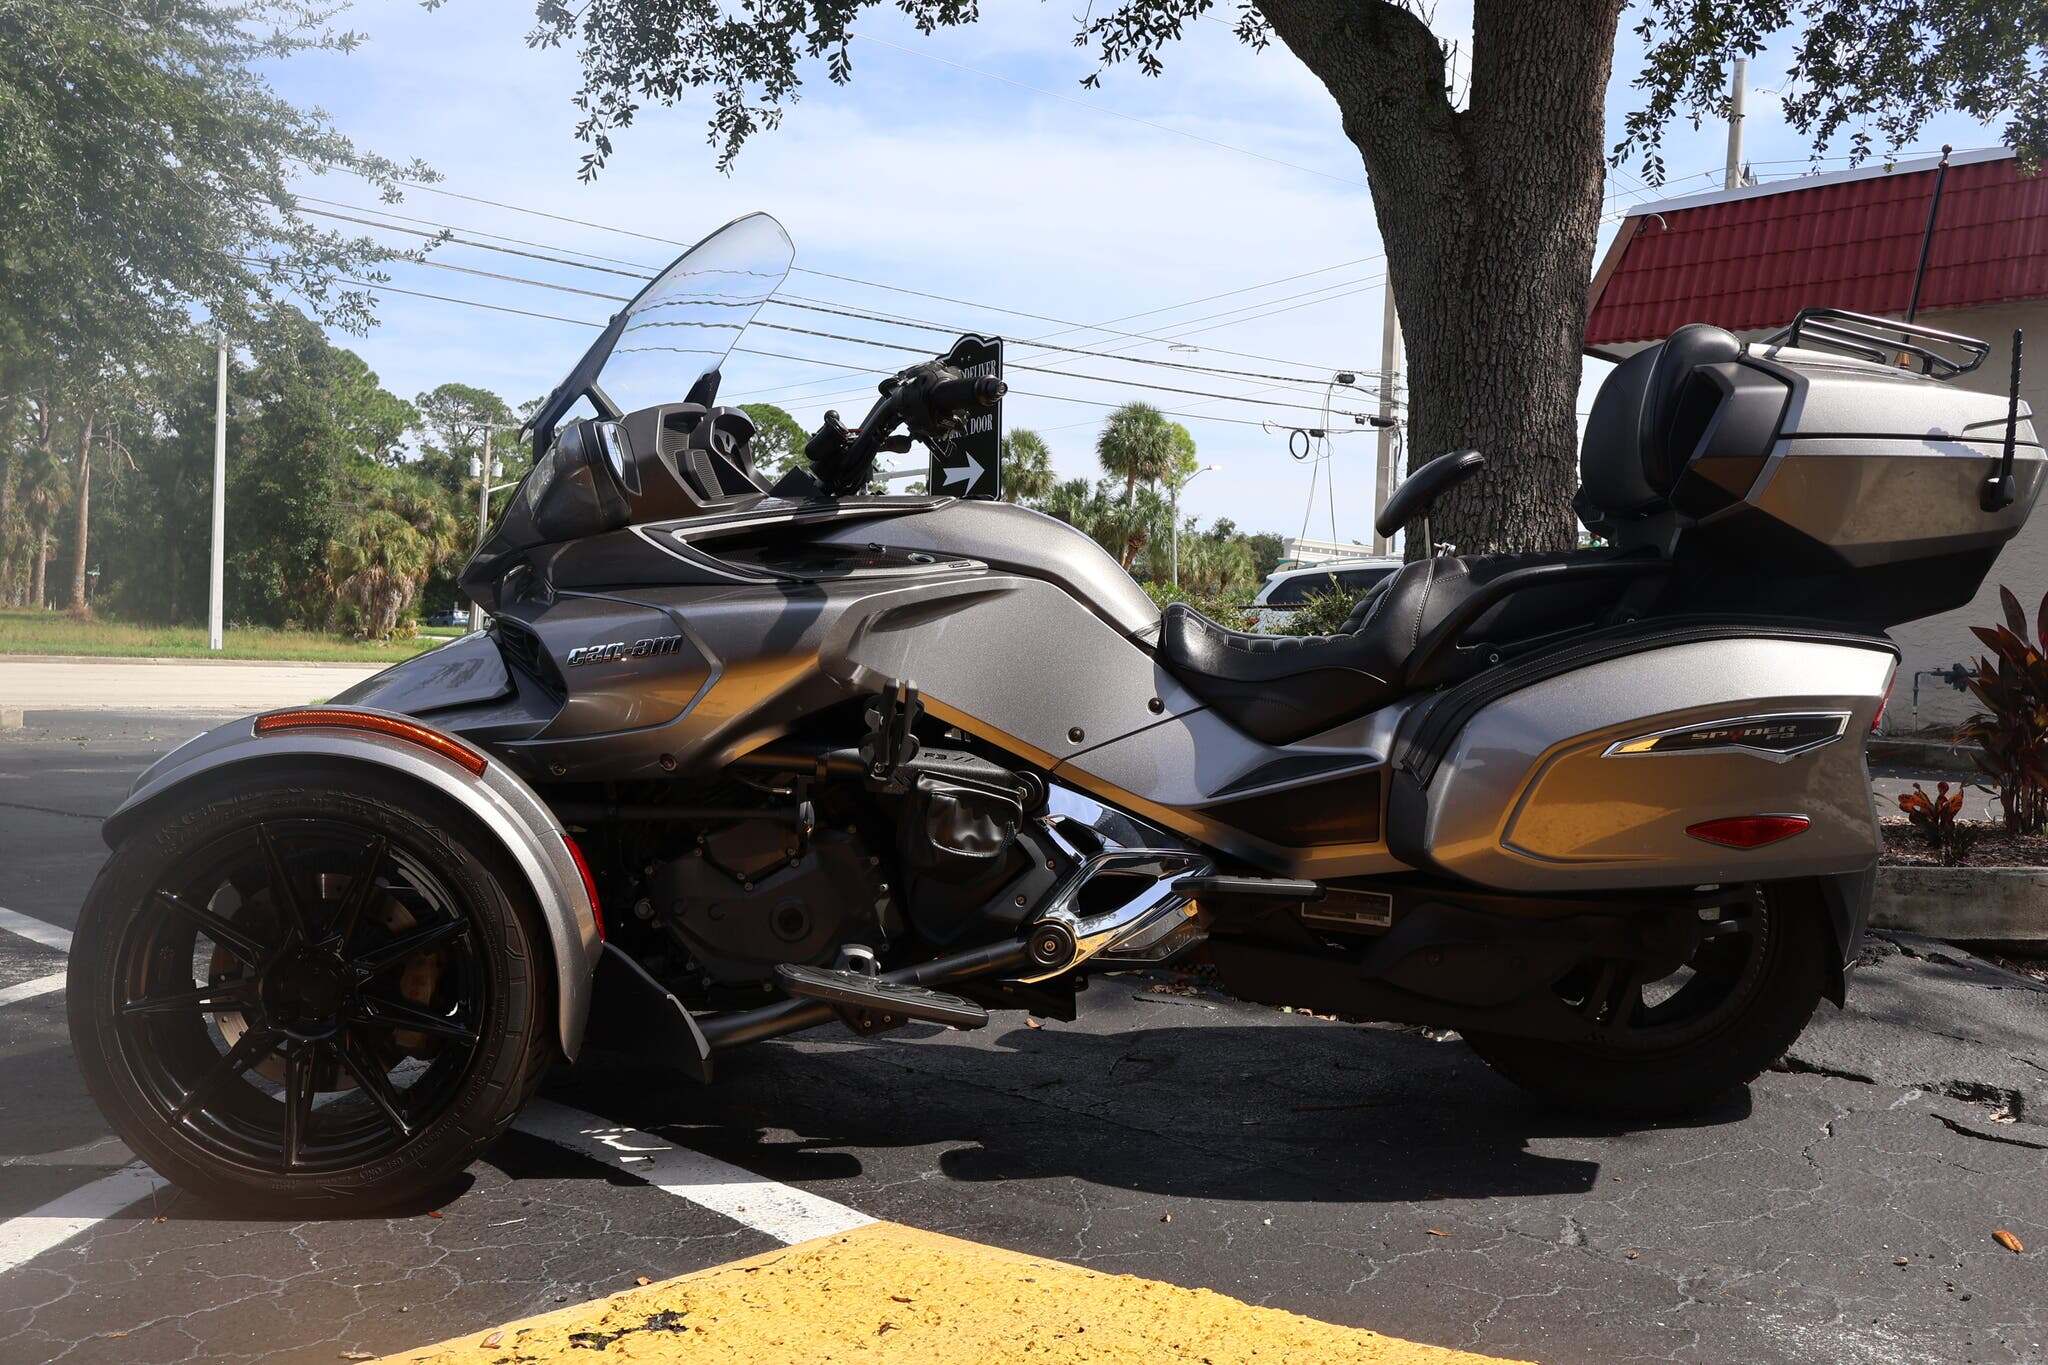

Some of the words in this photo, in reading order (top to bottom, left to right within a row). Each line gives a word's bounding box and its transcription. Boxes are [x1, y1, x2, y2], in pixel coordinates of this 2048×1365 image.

[970, 413, 993, 435] DOOR
[567, 635, 682, 666] can-am
[1691, 725, 1797, 742] SPYDER
